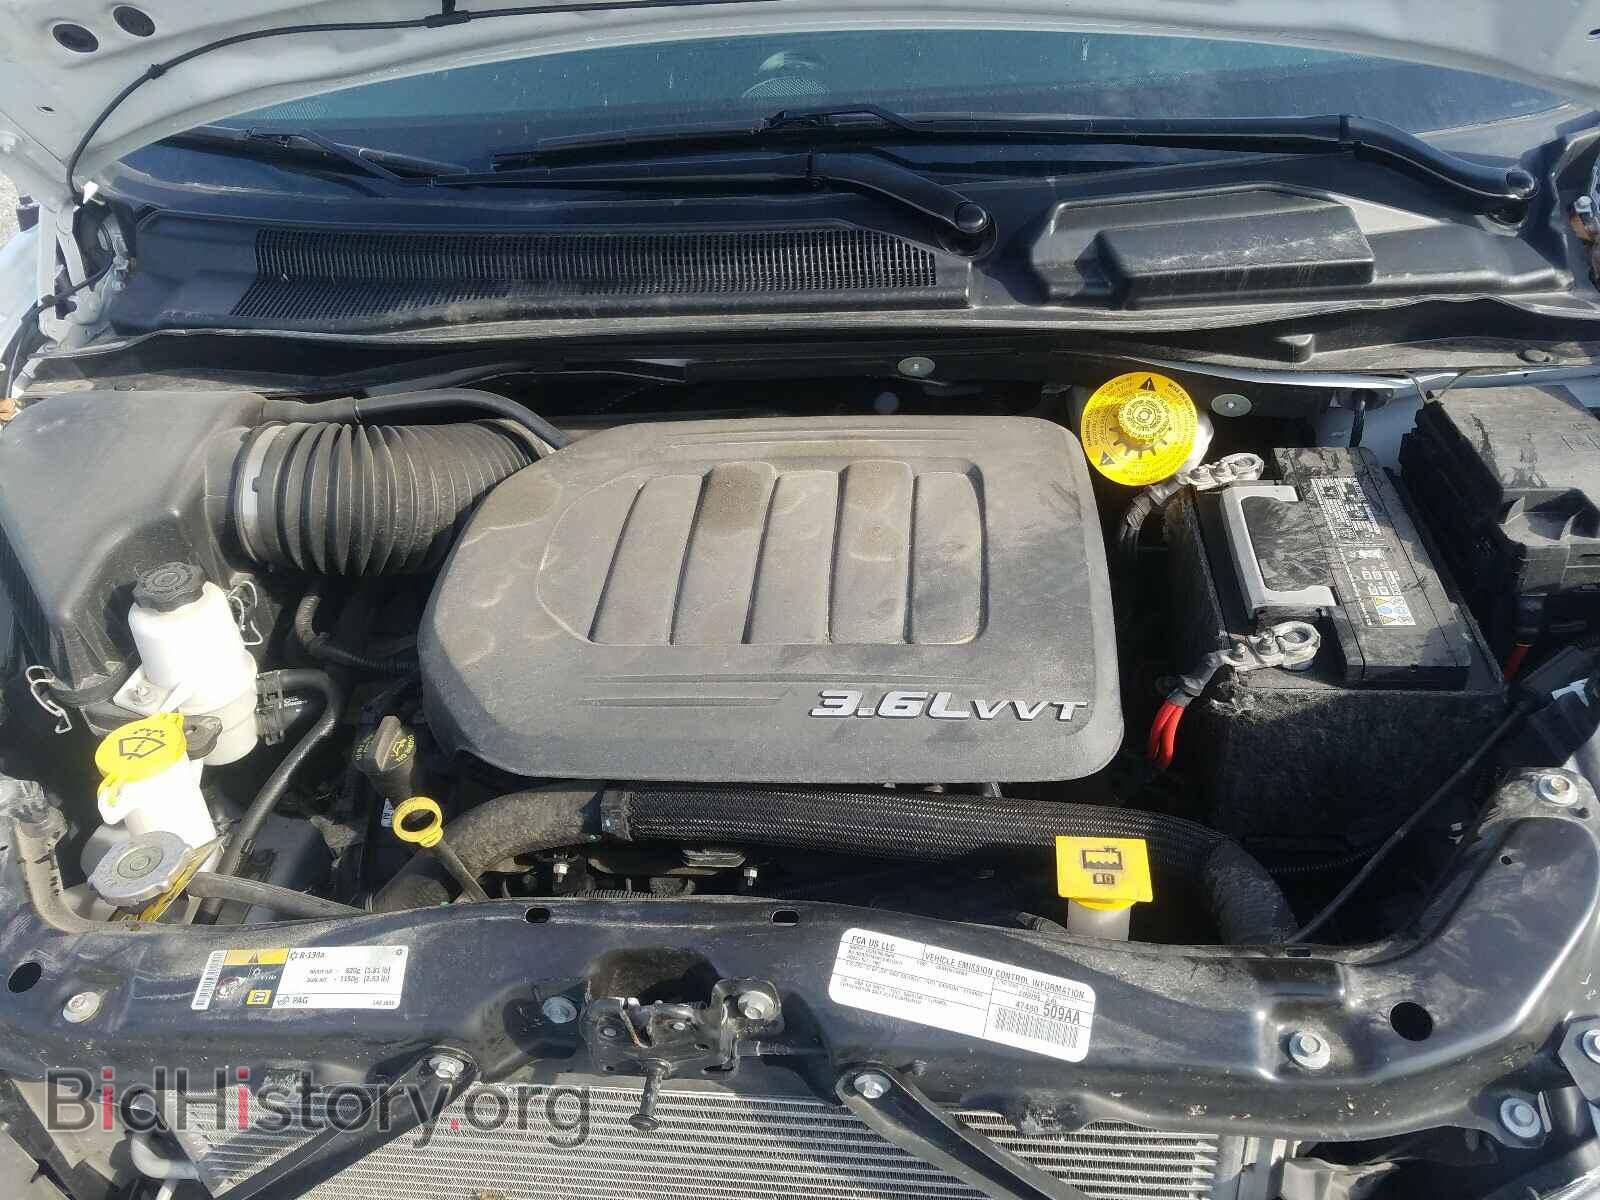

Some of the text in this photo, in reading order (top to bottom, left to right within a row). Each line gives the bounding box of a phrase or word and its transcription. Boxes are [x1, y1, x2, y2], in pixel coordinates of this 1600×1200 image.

[851, 935, 896, 952] FCA US LLC
[299, 951, 325, 960] R-134a
[925, 951, 956, 967] VEHICLE
[957, 959, 993, 976] EMISSION
[995, 969, 1029, 986] CONTROL
[1031, 978, 1085, 999] INFORMATION
[292, 996, 309, 1004] PAG
[1042, 1005, 1080, 1025] 509AA
